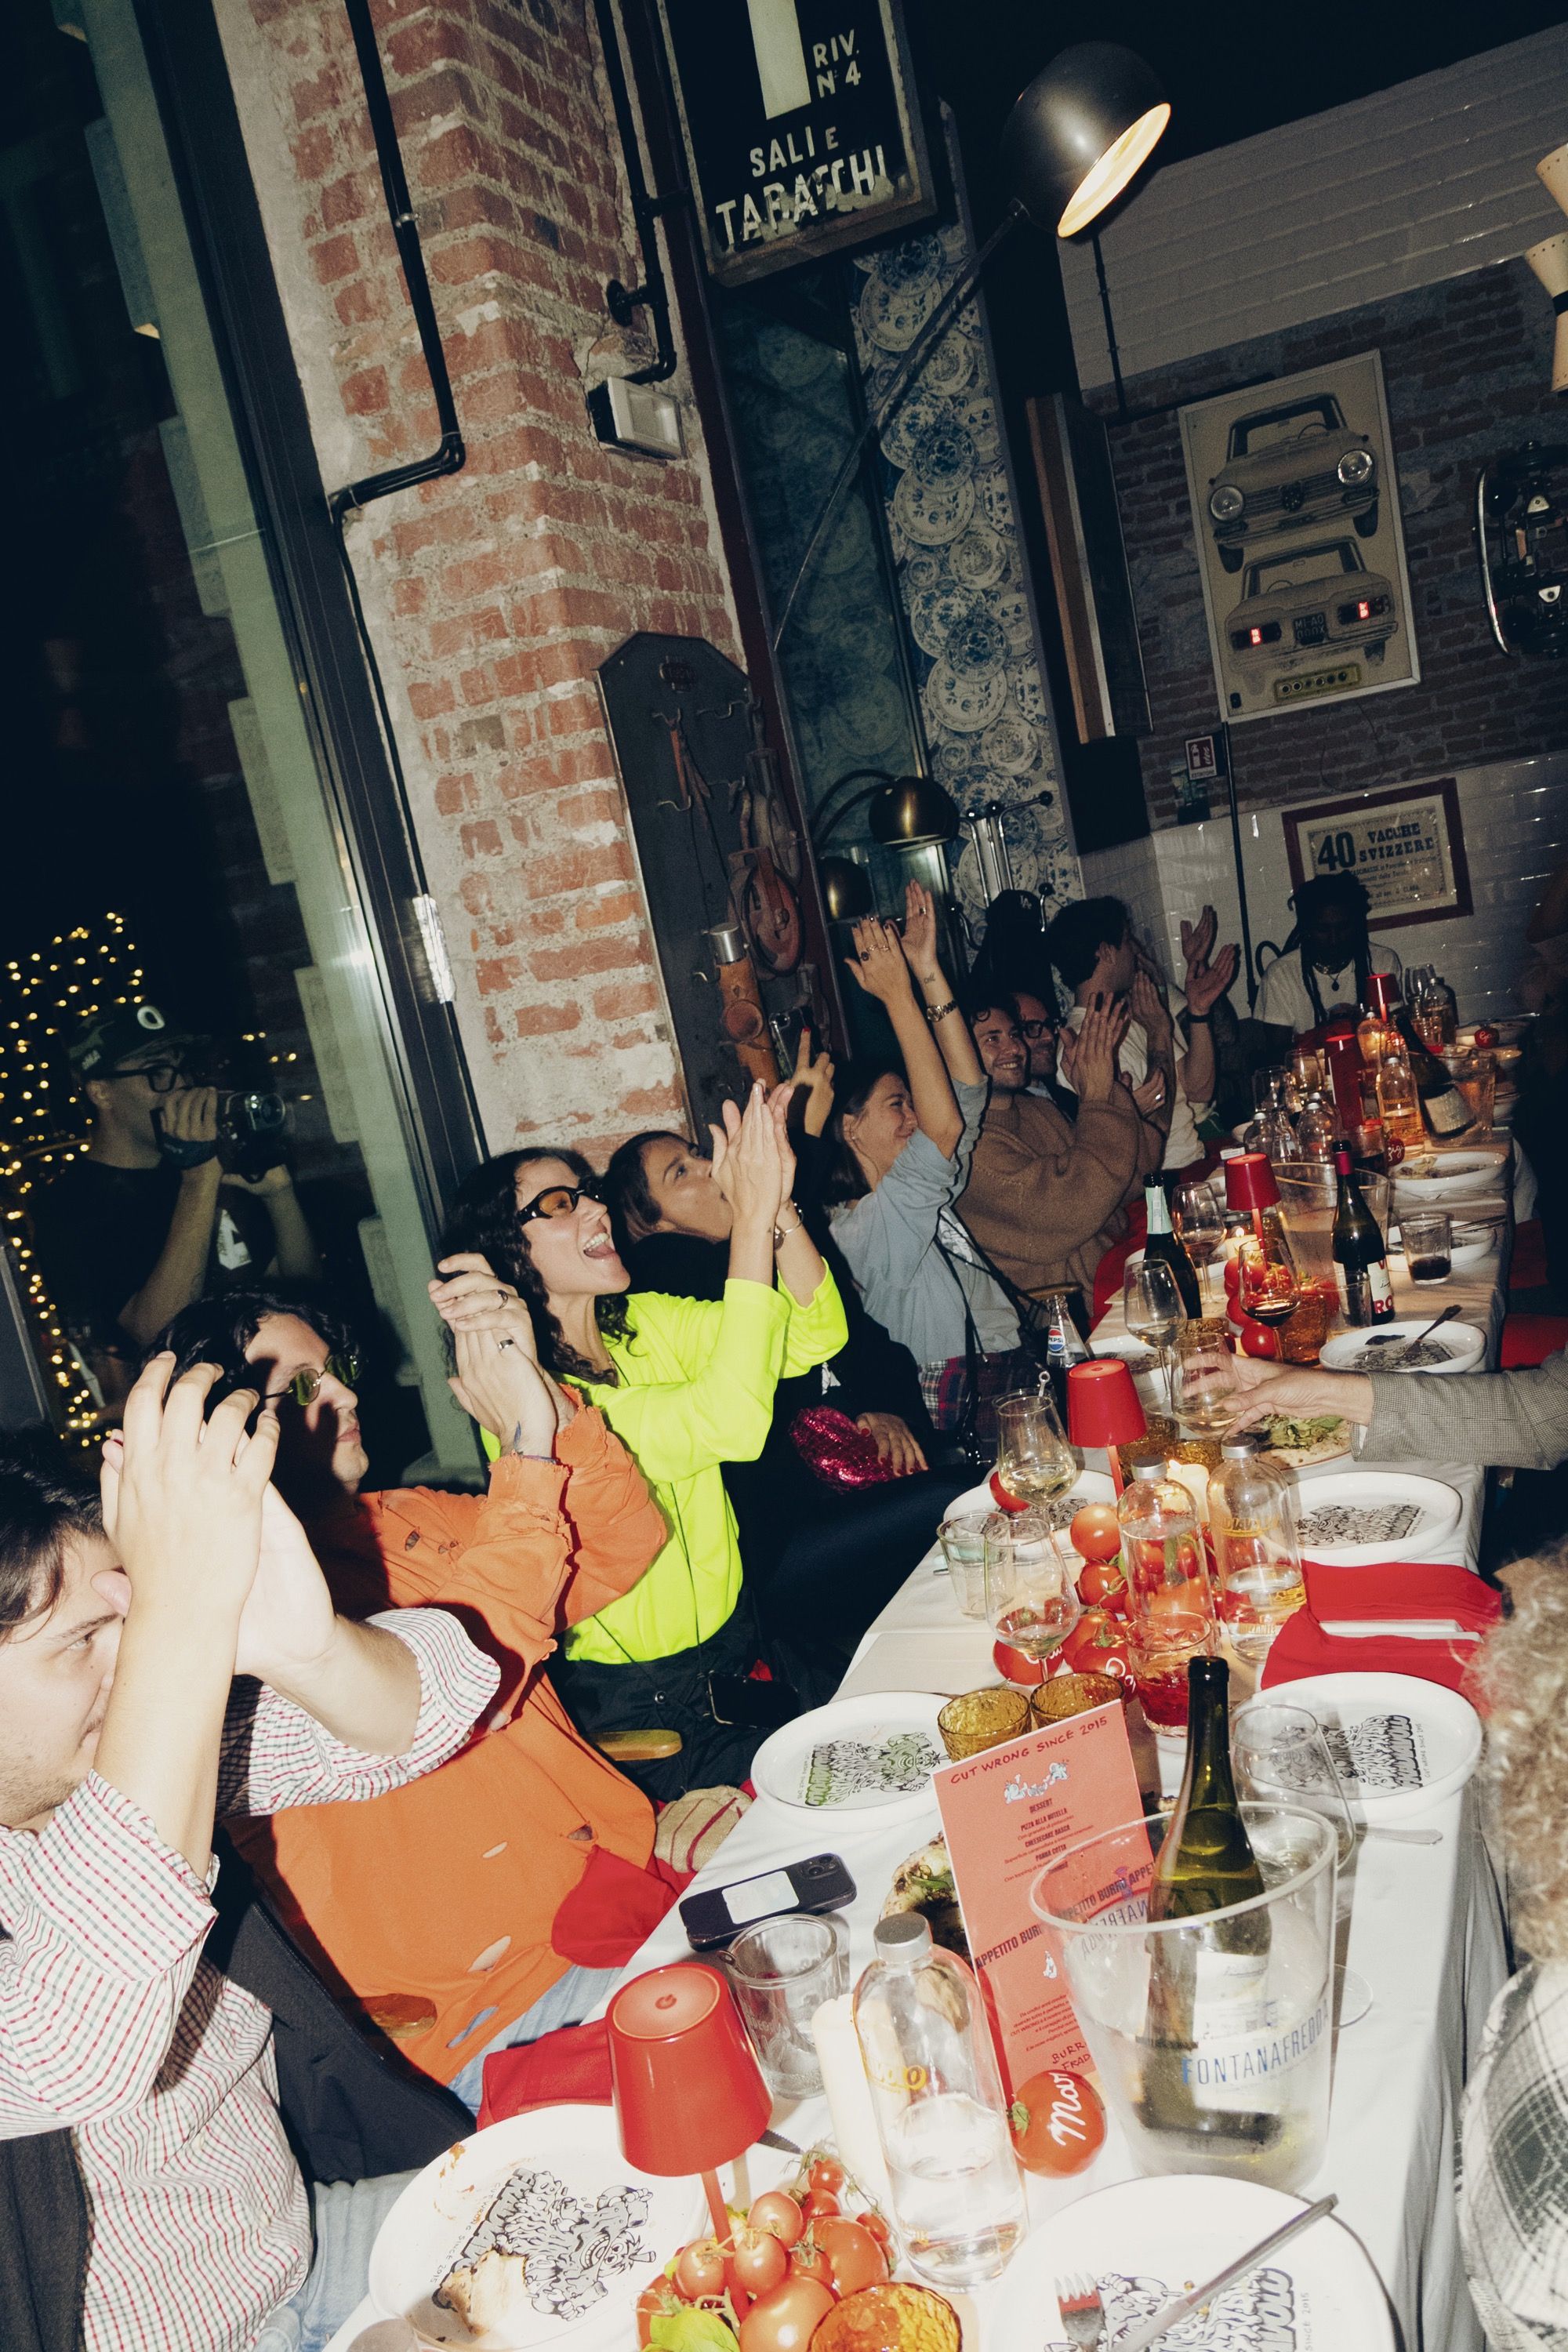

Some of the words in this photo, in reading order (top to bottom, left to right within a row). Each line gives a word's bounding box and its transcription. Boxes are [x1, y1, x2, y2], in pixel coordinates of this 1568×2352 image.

[812, 28, 860, 69] RIV.
[844, 60, 862, 86] 4
[750, 125, 815, 178] SALI
[826, 126, 840, 151] E
[715, 144, 887, 246] TABACCHI
[1367, 822, 1421, 844] VACCHE
[1318, 831, 1356, 872] 40
[1359, 837, 1435, 862] SVIZZERE
[950, 1766, 978, 1784] CUT
[981, 1748, 1030, 1773] WRONG
[1036, 1730, 1075, 1753] SINCE
[1080, 1715, 1108, 1736] 2015
[1029, 1798, 1053, 1813] DESSERT
[1020, 1821, 1034, 1831] PIZZA
[1098, 1879, 1128, 1902] BURRO
[975, 1936, 1018, 1969] APPETITO
[1181, 1998, 1330, 2085] FONTANAFREDDA
[430, 2263, 447, 2284] 2015
[1300, 2292, 1312, 2315] 2015
